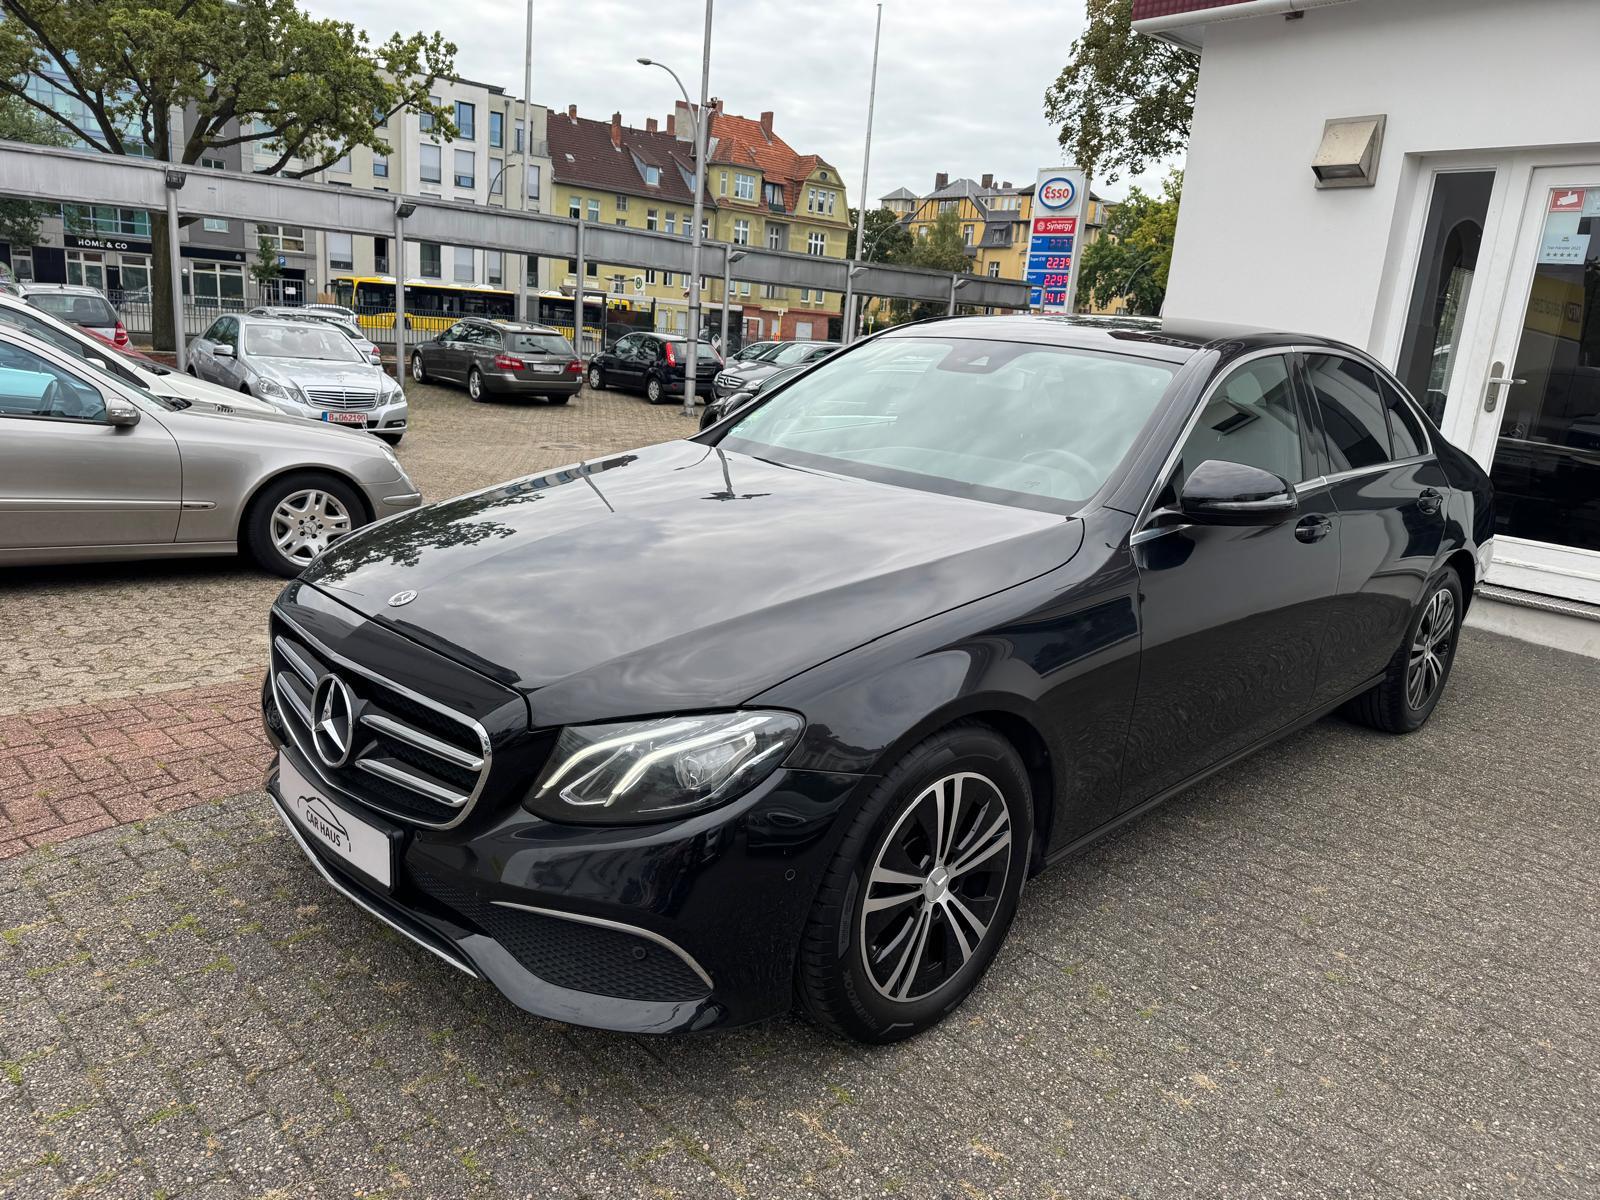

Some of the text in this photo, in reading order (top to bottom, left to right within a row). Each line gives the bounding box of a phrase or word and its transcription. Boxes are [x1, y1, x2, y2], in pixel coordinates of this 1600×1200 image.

[1044, 186, 1069, 199] Esso
[1046, 222, 1073, 232] Synergy
[329, 413, 334, 421] B
[306, 809, 341, 847] CAR HAUS
